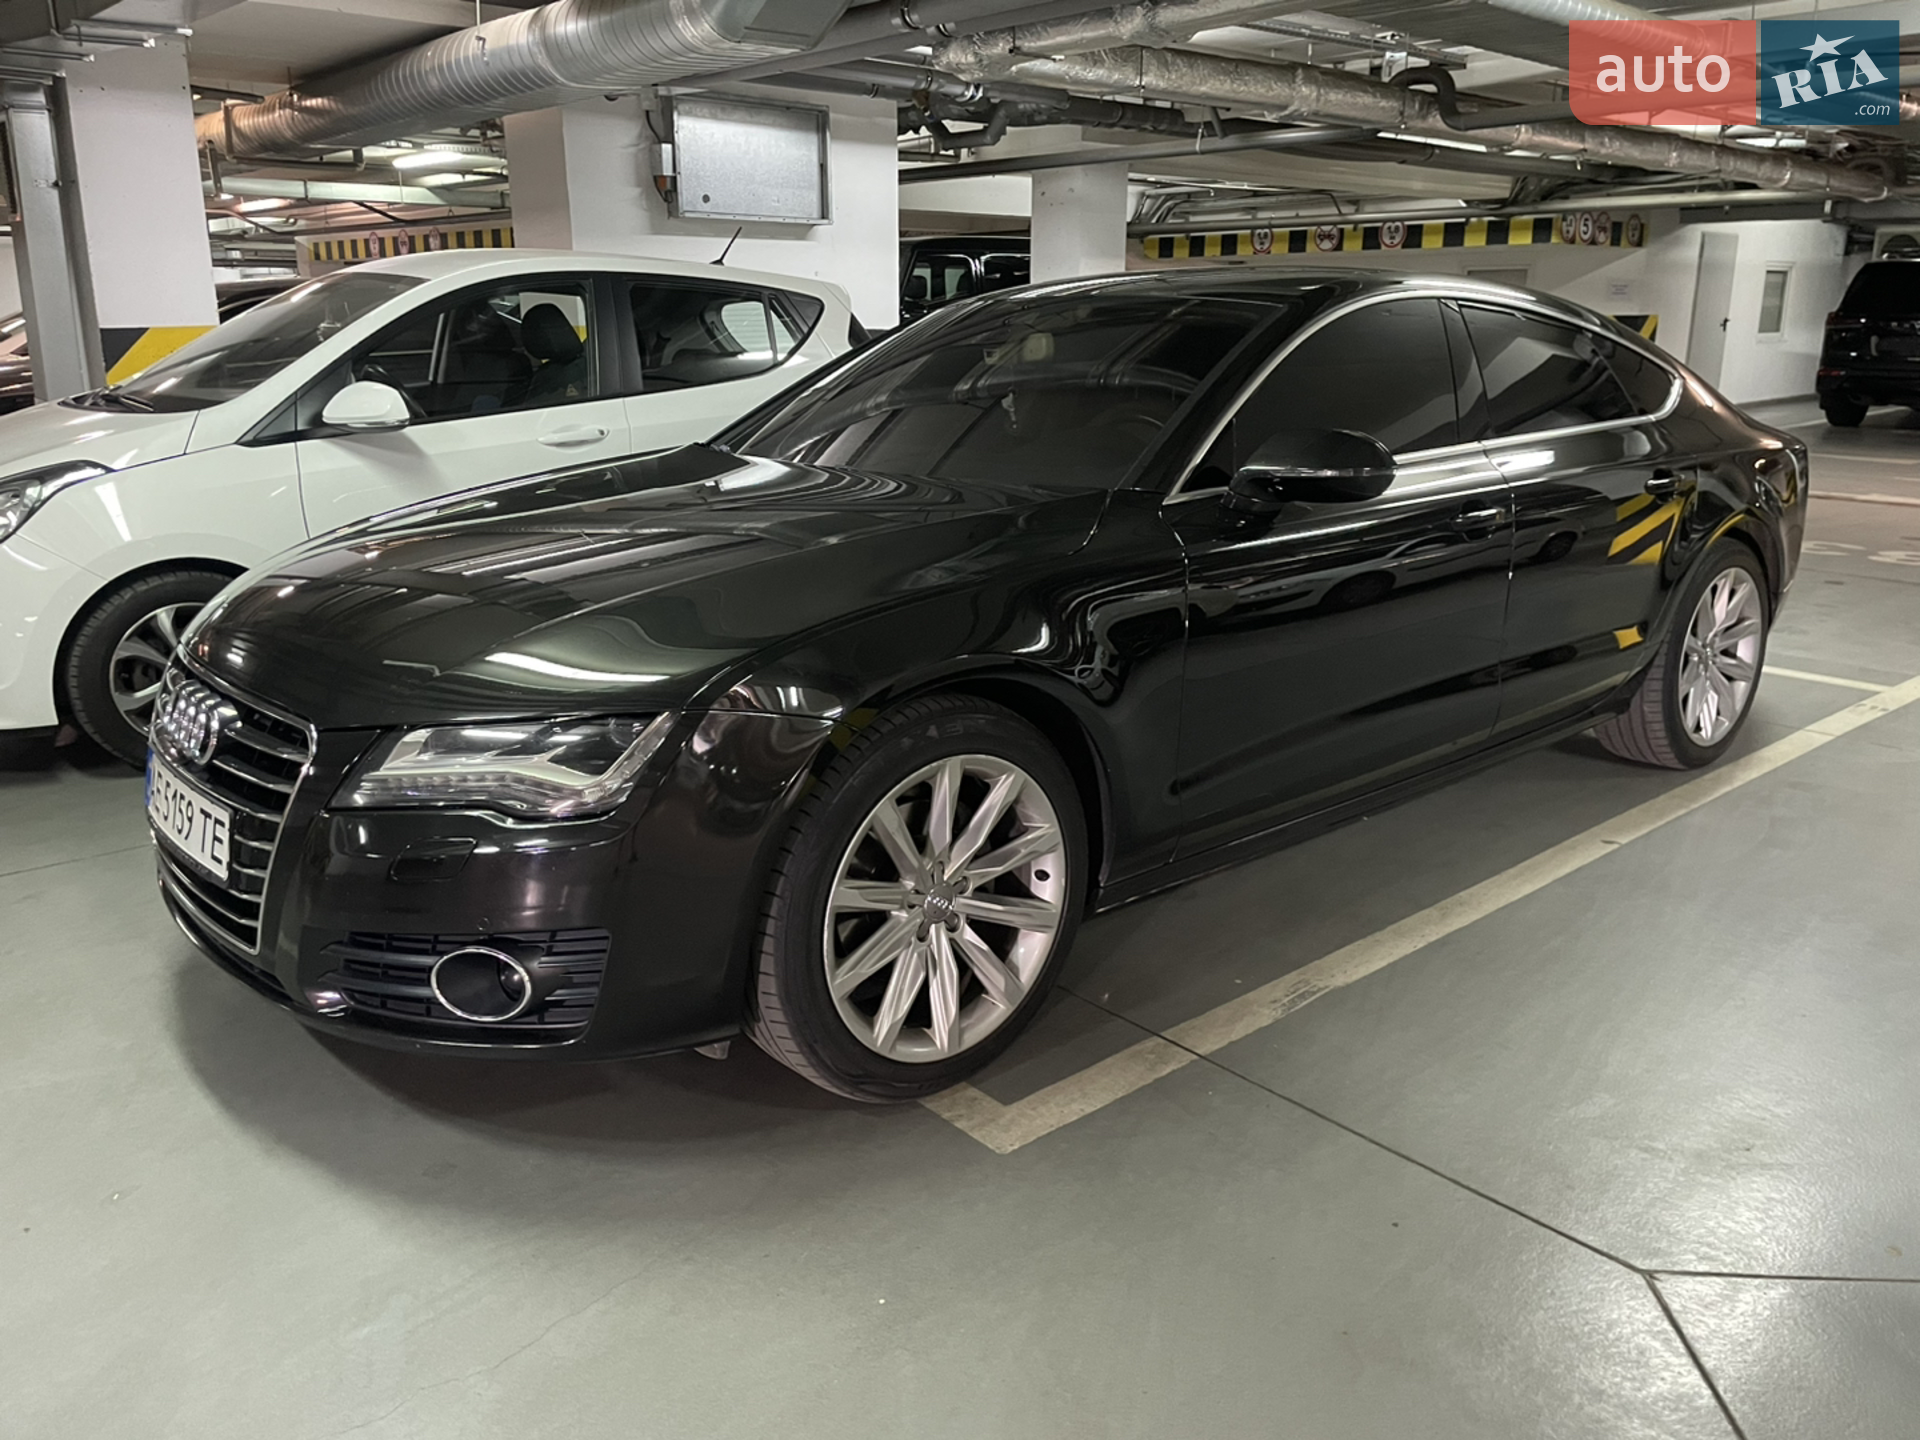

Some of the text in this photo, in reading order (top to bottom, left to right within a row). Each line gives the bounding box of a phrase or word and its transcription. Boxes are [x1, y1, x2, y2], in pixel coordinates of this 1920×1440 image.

[1582, 218, 1589, 235] 5
[163, 780, 194, 840] 5159
[200, 808, 225, 865] TE
